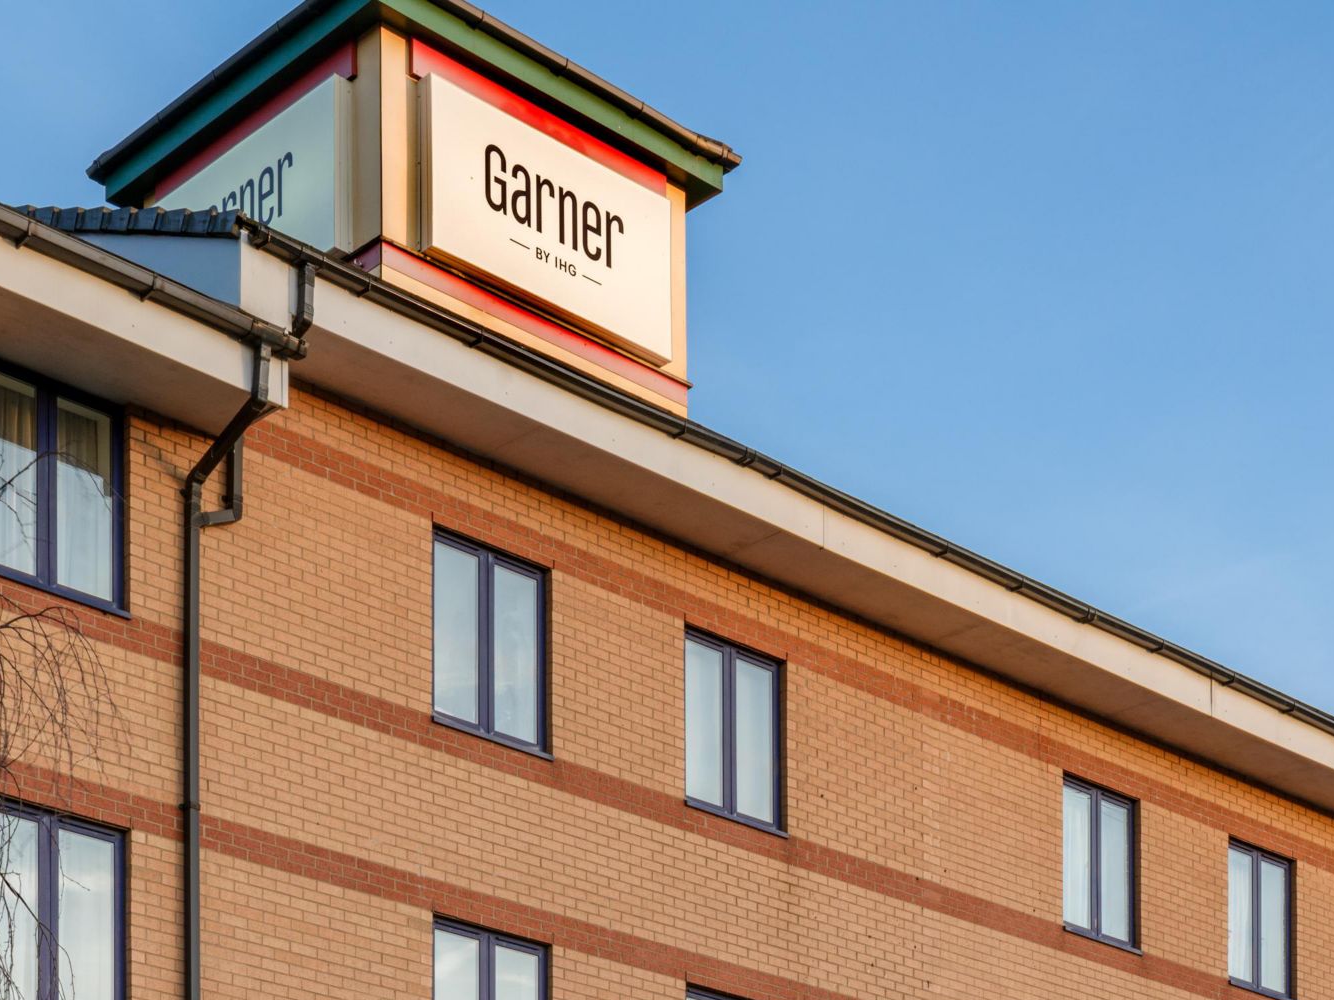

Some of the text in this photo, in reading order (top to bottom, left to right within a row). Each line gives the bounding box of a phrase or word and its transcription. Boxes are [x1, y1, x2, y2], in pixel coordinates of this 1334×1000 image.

[209, 151, 293, 226] rner
[485, 144, 624, 269] Garner
[535, 247, 577, 277] BY IHG
